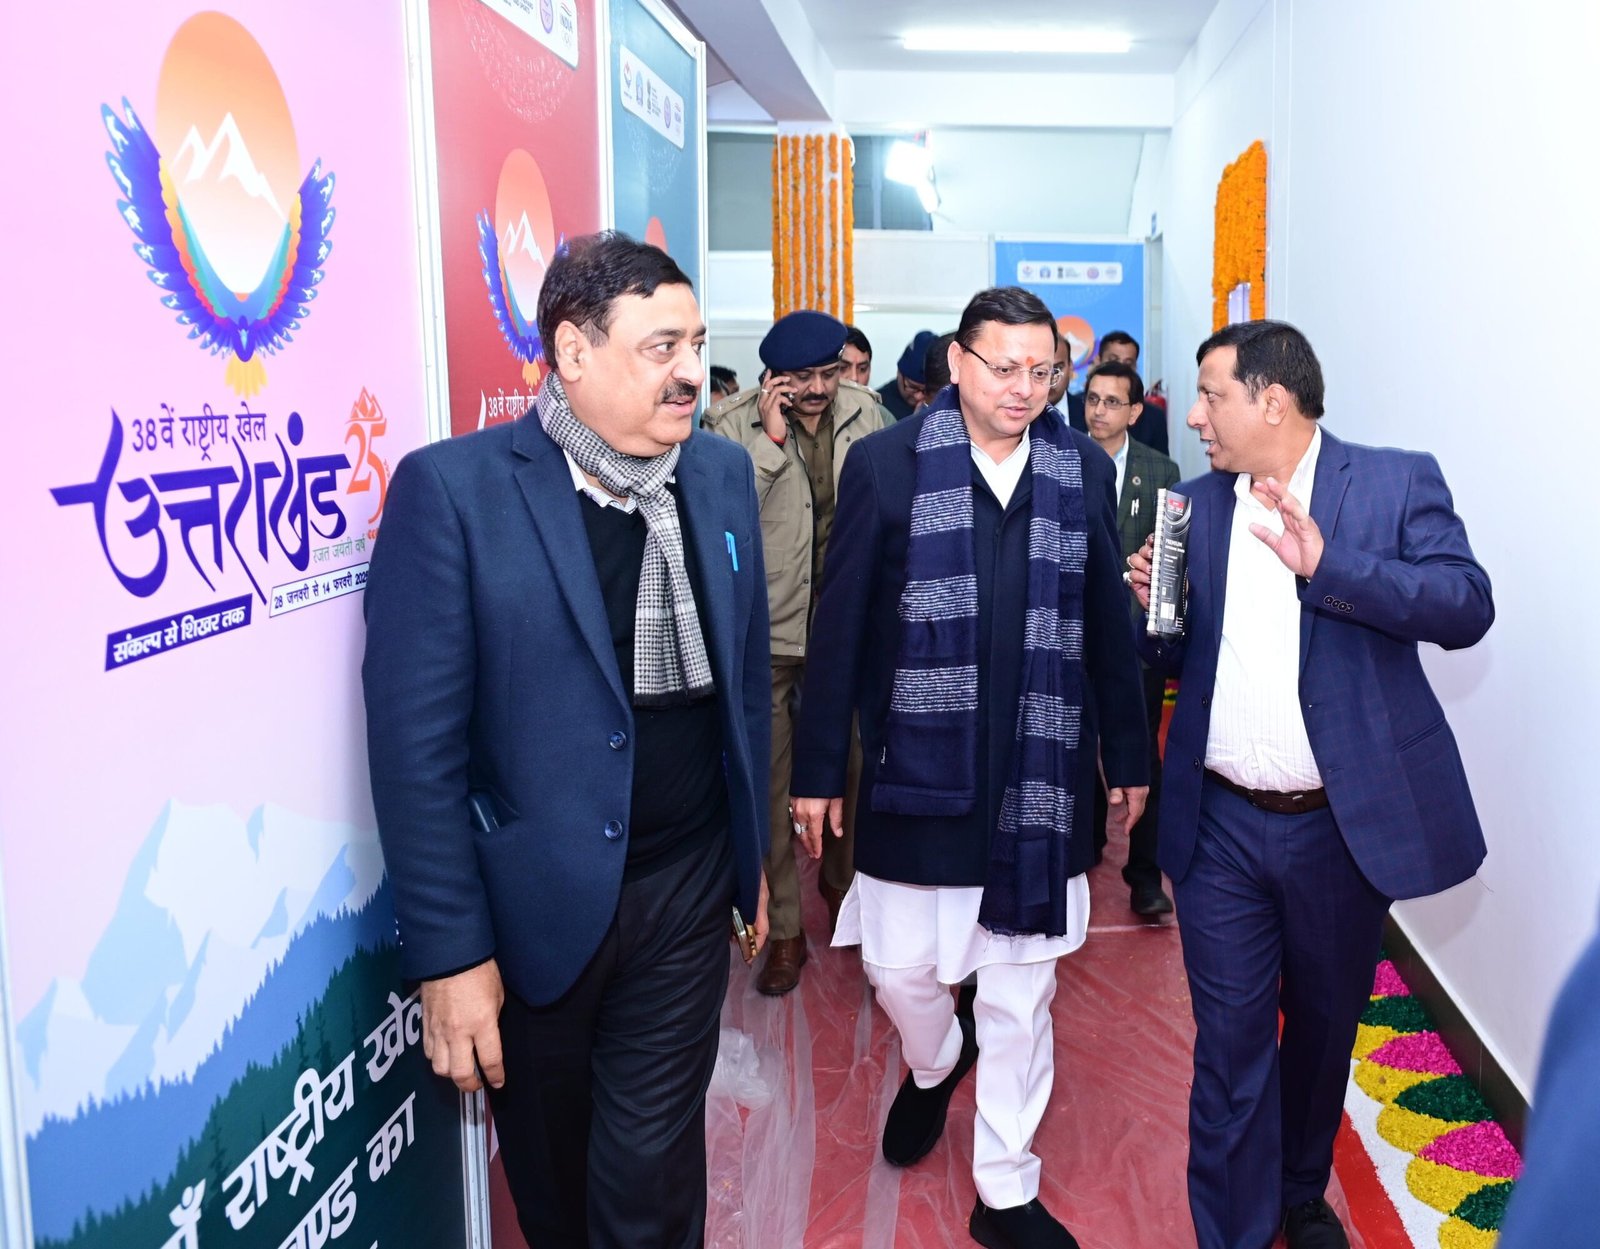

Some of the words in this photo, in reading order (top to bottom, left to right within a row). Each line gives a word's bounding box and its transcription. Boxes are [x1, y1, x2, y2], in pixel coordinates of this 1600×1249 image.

[178, 402, 230, 461] राष्ट्रीय
[235, 401, 267, 442] खेल
[48, 405, 352, 606] उत्तराखंड
[344, 417, 387, 525] 25
[312, 546, 330, 563] रजत
[332, 536, 353, 558] जयंती
[354, 532, 366, 552] वर्ष
[274, 595, 284, 609] 28
[286, 583, 310, 604] जनवरी
[312, 580, 319, 597] से
[322, 581, 330, 595] 14
[333, 571, 353, 591] फरवरी
[113, 633, 163, 663] संकल्प
[164, 619, 179, 646] से
[181, 614, 221, 641] शिखर
[221, 605, 246, 628] तक
[222, 1051, 356, 1230] राष्ट्रीय
[366, 1090, 416, 1182] का
